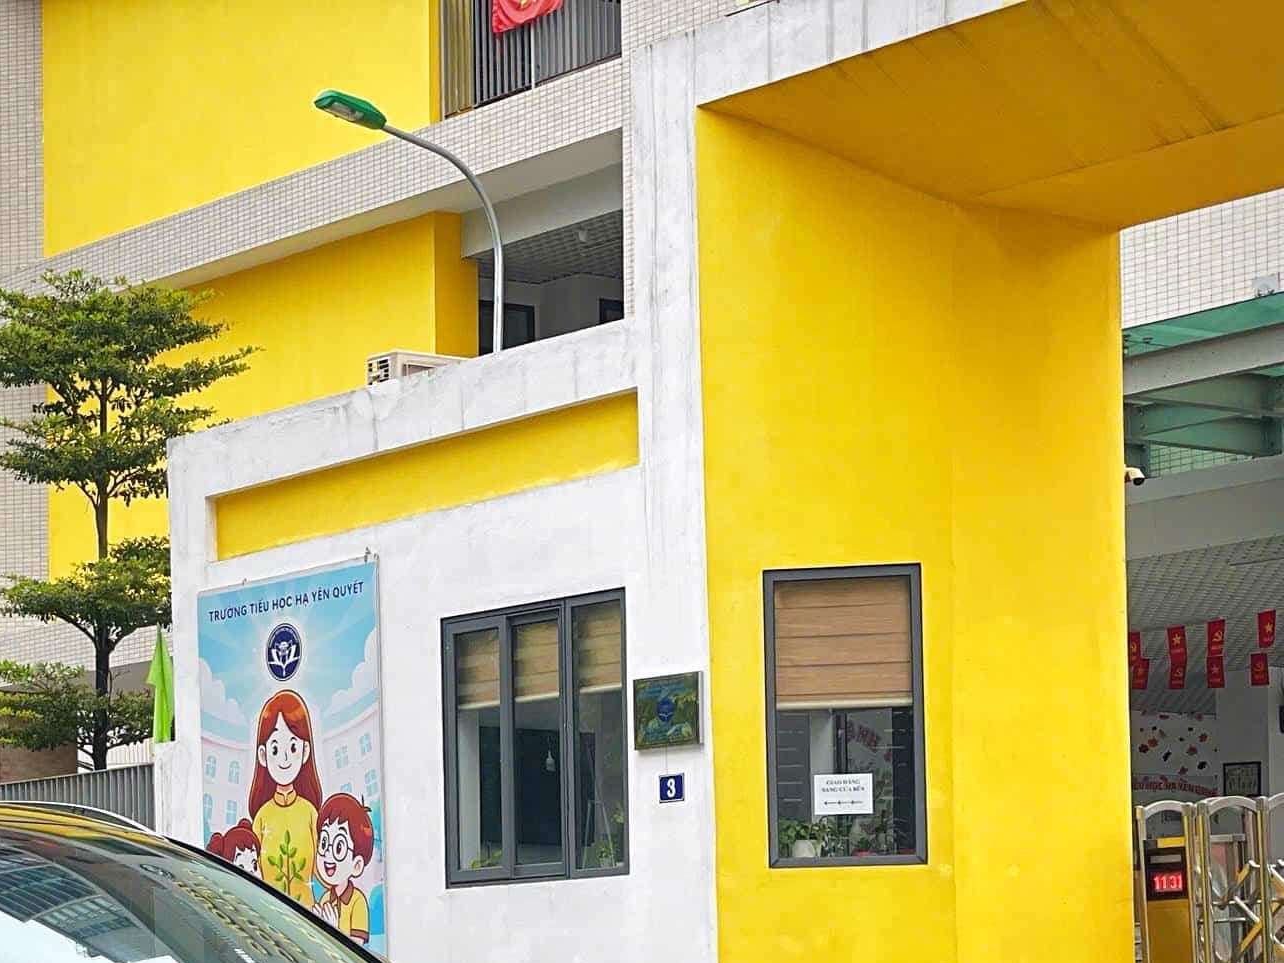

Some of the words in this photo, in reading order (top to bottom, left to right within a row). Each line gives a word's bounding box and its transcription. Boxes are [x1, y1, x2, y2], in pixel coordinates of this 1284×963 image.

[295, 592, 309, 608] HẠ
[311, 586, 330, 602] YÊN
[332, 579, 364, 599] QUYẾT
[667, 778, 676, 798] 3
